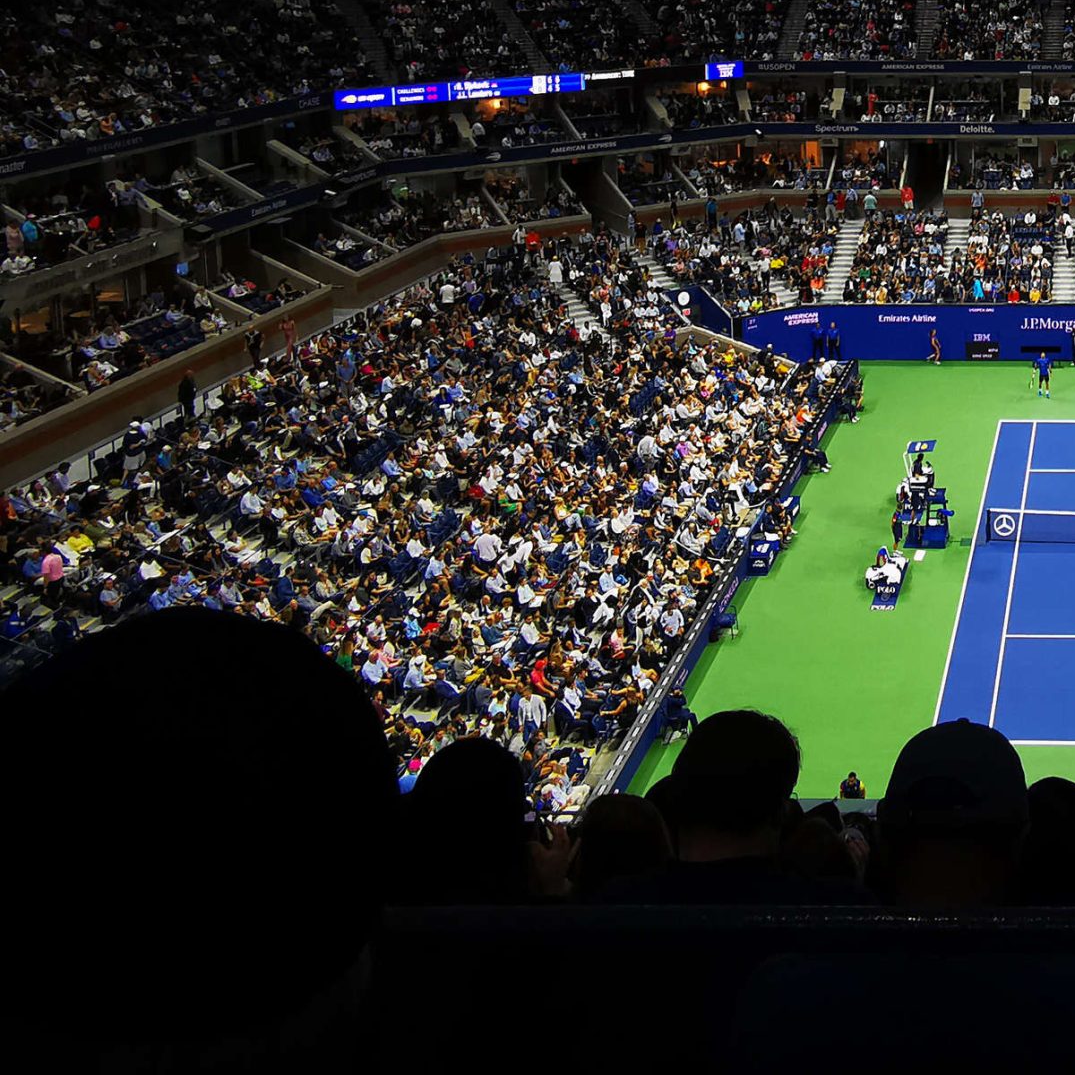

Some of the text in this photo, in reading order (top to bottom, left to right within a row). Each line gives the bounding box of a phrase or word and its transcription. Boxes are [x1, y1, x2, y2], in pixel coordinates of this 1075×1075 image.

[547, 76, 553, 84] 6
[815, 124, 855, 133] Spectrum
[550, 144, 586, 155] AMERICAN
[783, 312, 819, 322] AMERICAN
[877, 314, 936, 323] Emirates Airline
[788, 318, 819, 326] EXPRESS
[973, 333, 991, 342] IBM
[877, 586, 896, 594] POLO
